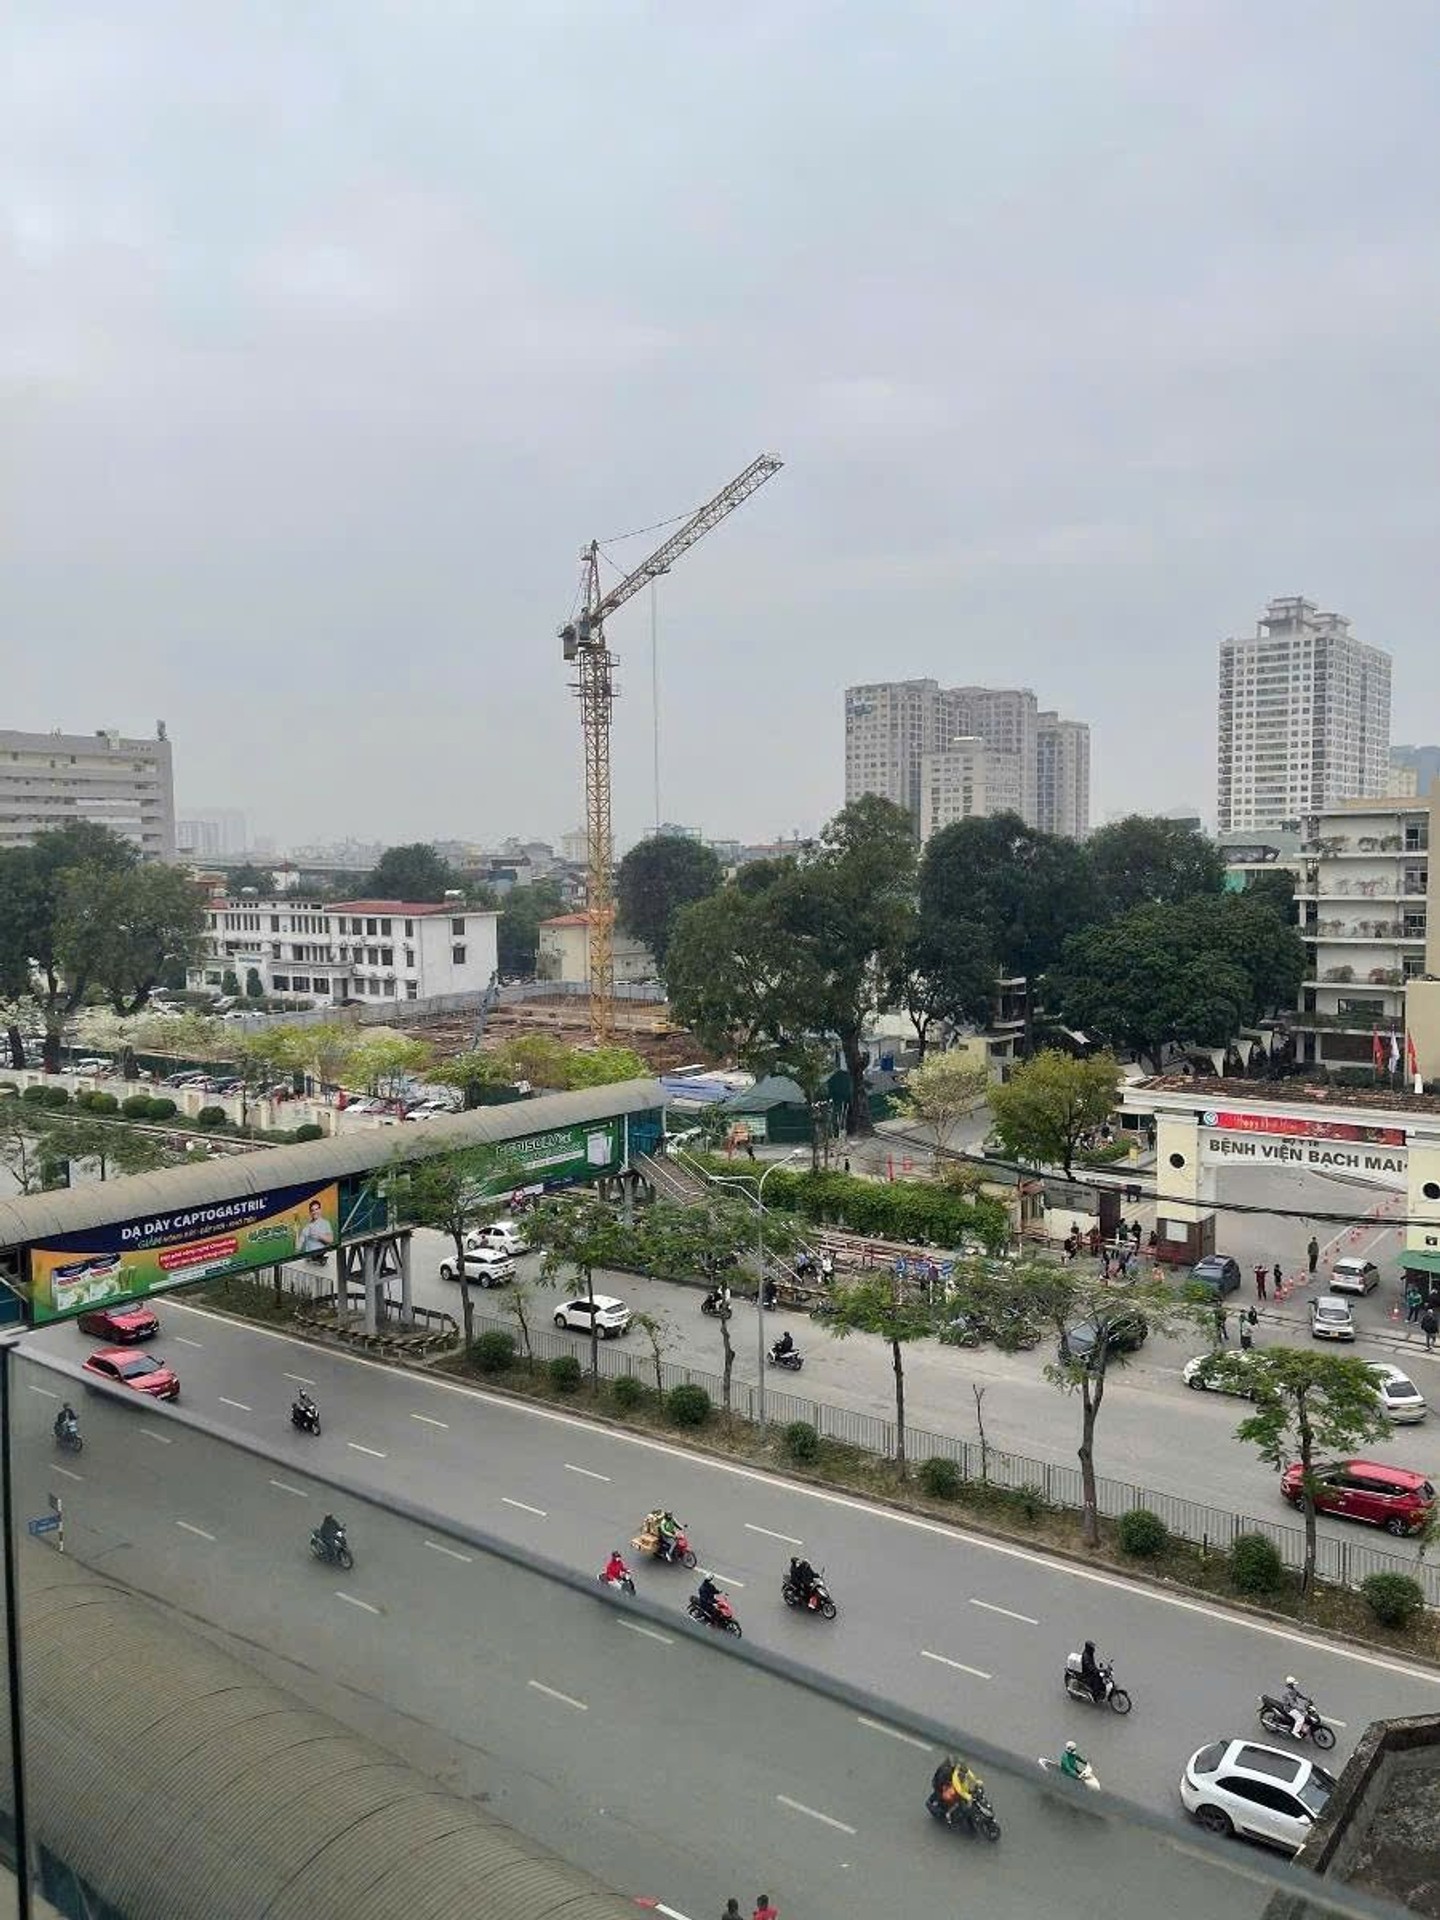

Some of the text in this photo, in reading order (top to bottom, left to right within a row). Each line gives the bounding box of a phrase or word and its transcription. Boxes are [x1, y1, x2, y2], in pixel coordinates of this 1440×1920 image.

[1209, 1137, 1403, 1173] BỆNH VIỆN BẠCH MAI
[121, 1226, 141, 1240] DẠ
[144, 1217, 171, 1235] DÀY
